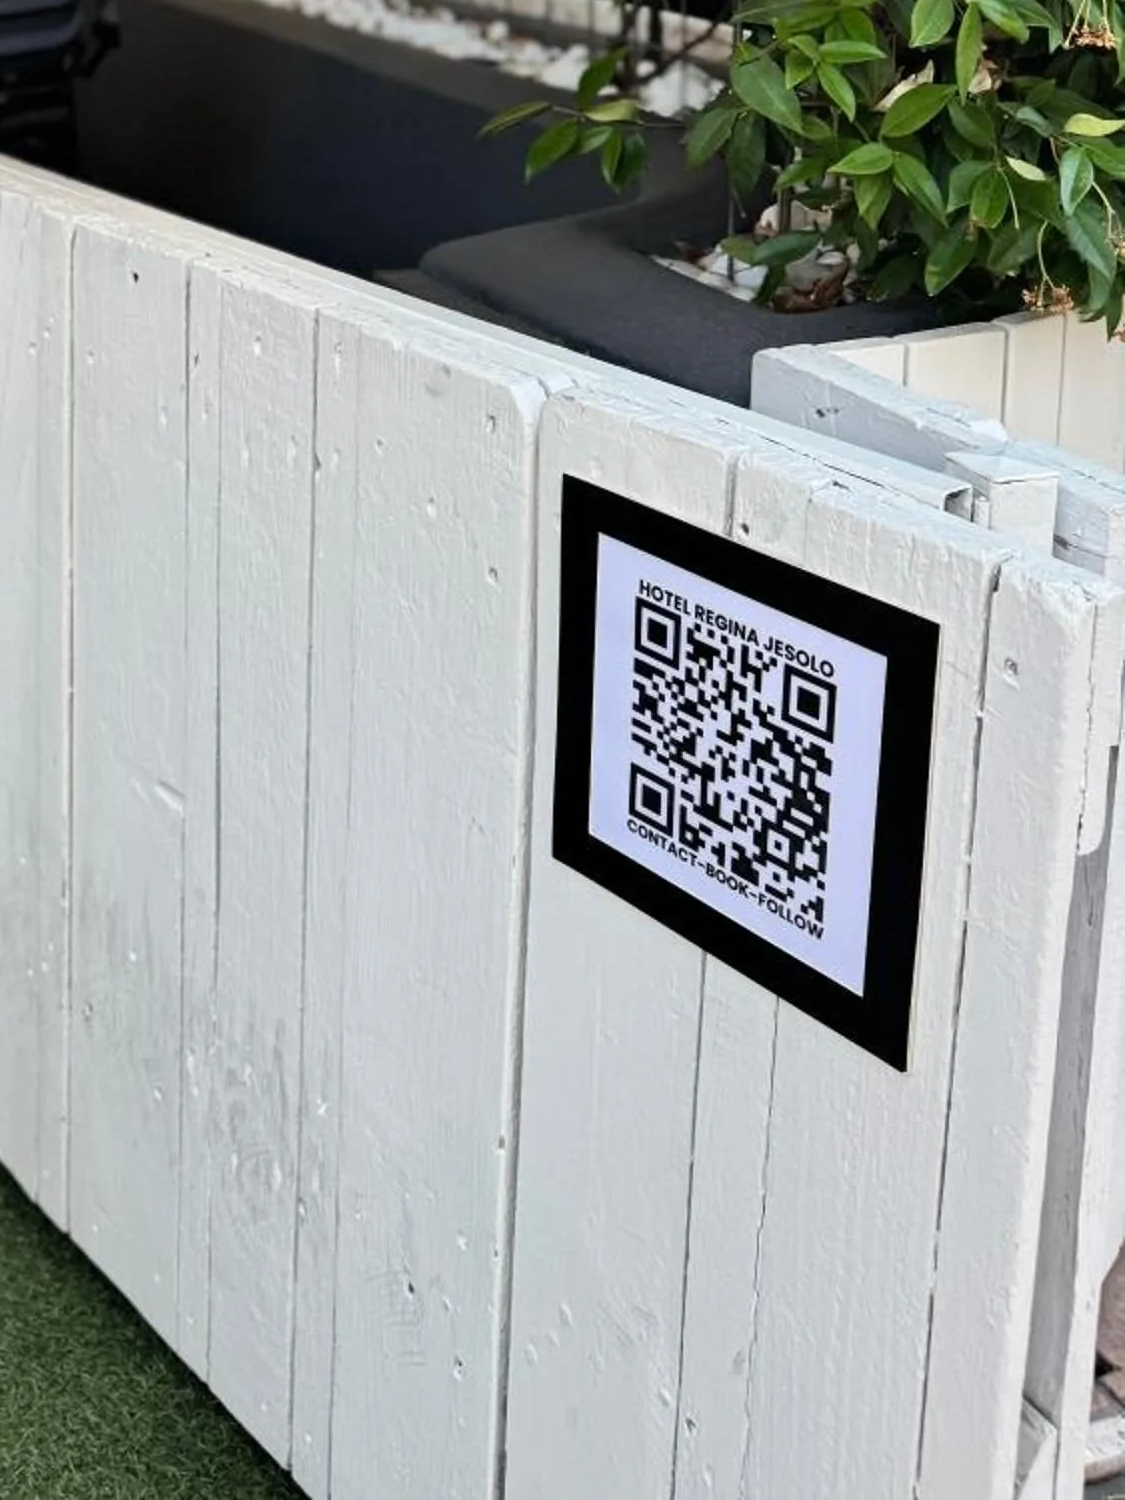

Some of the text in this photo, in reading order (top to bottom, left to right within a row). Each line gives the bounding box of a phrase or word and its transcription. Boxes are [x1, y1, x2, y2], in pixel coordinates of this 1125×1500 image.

[639, 579, 834, 678] HOTEL REGINA JESOLO
